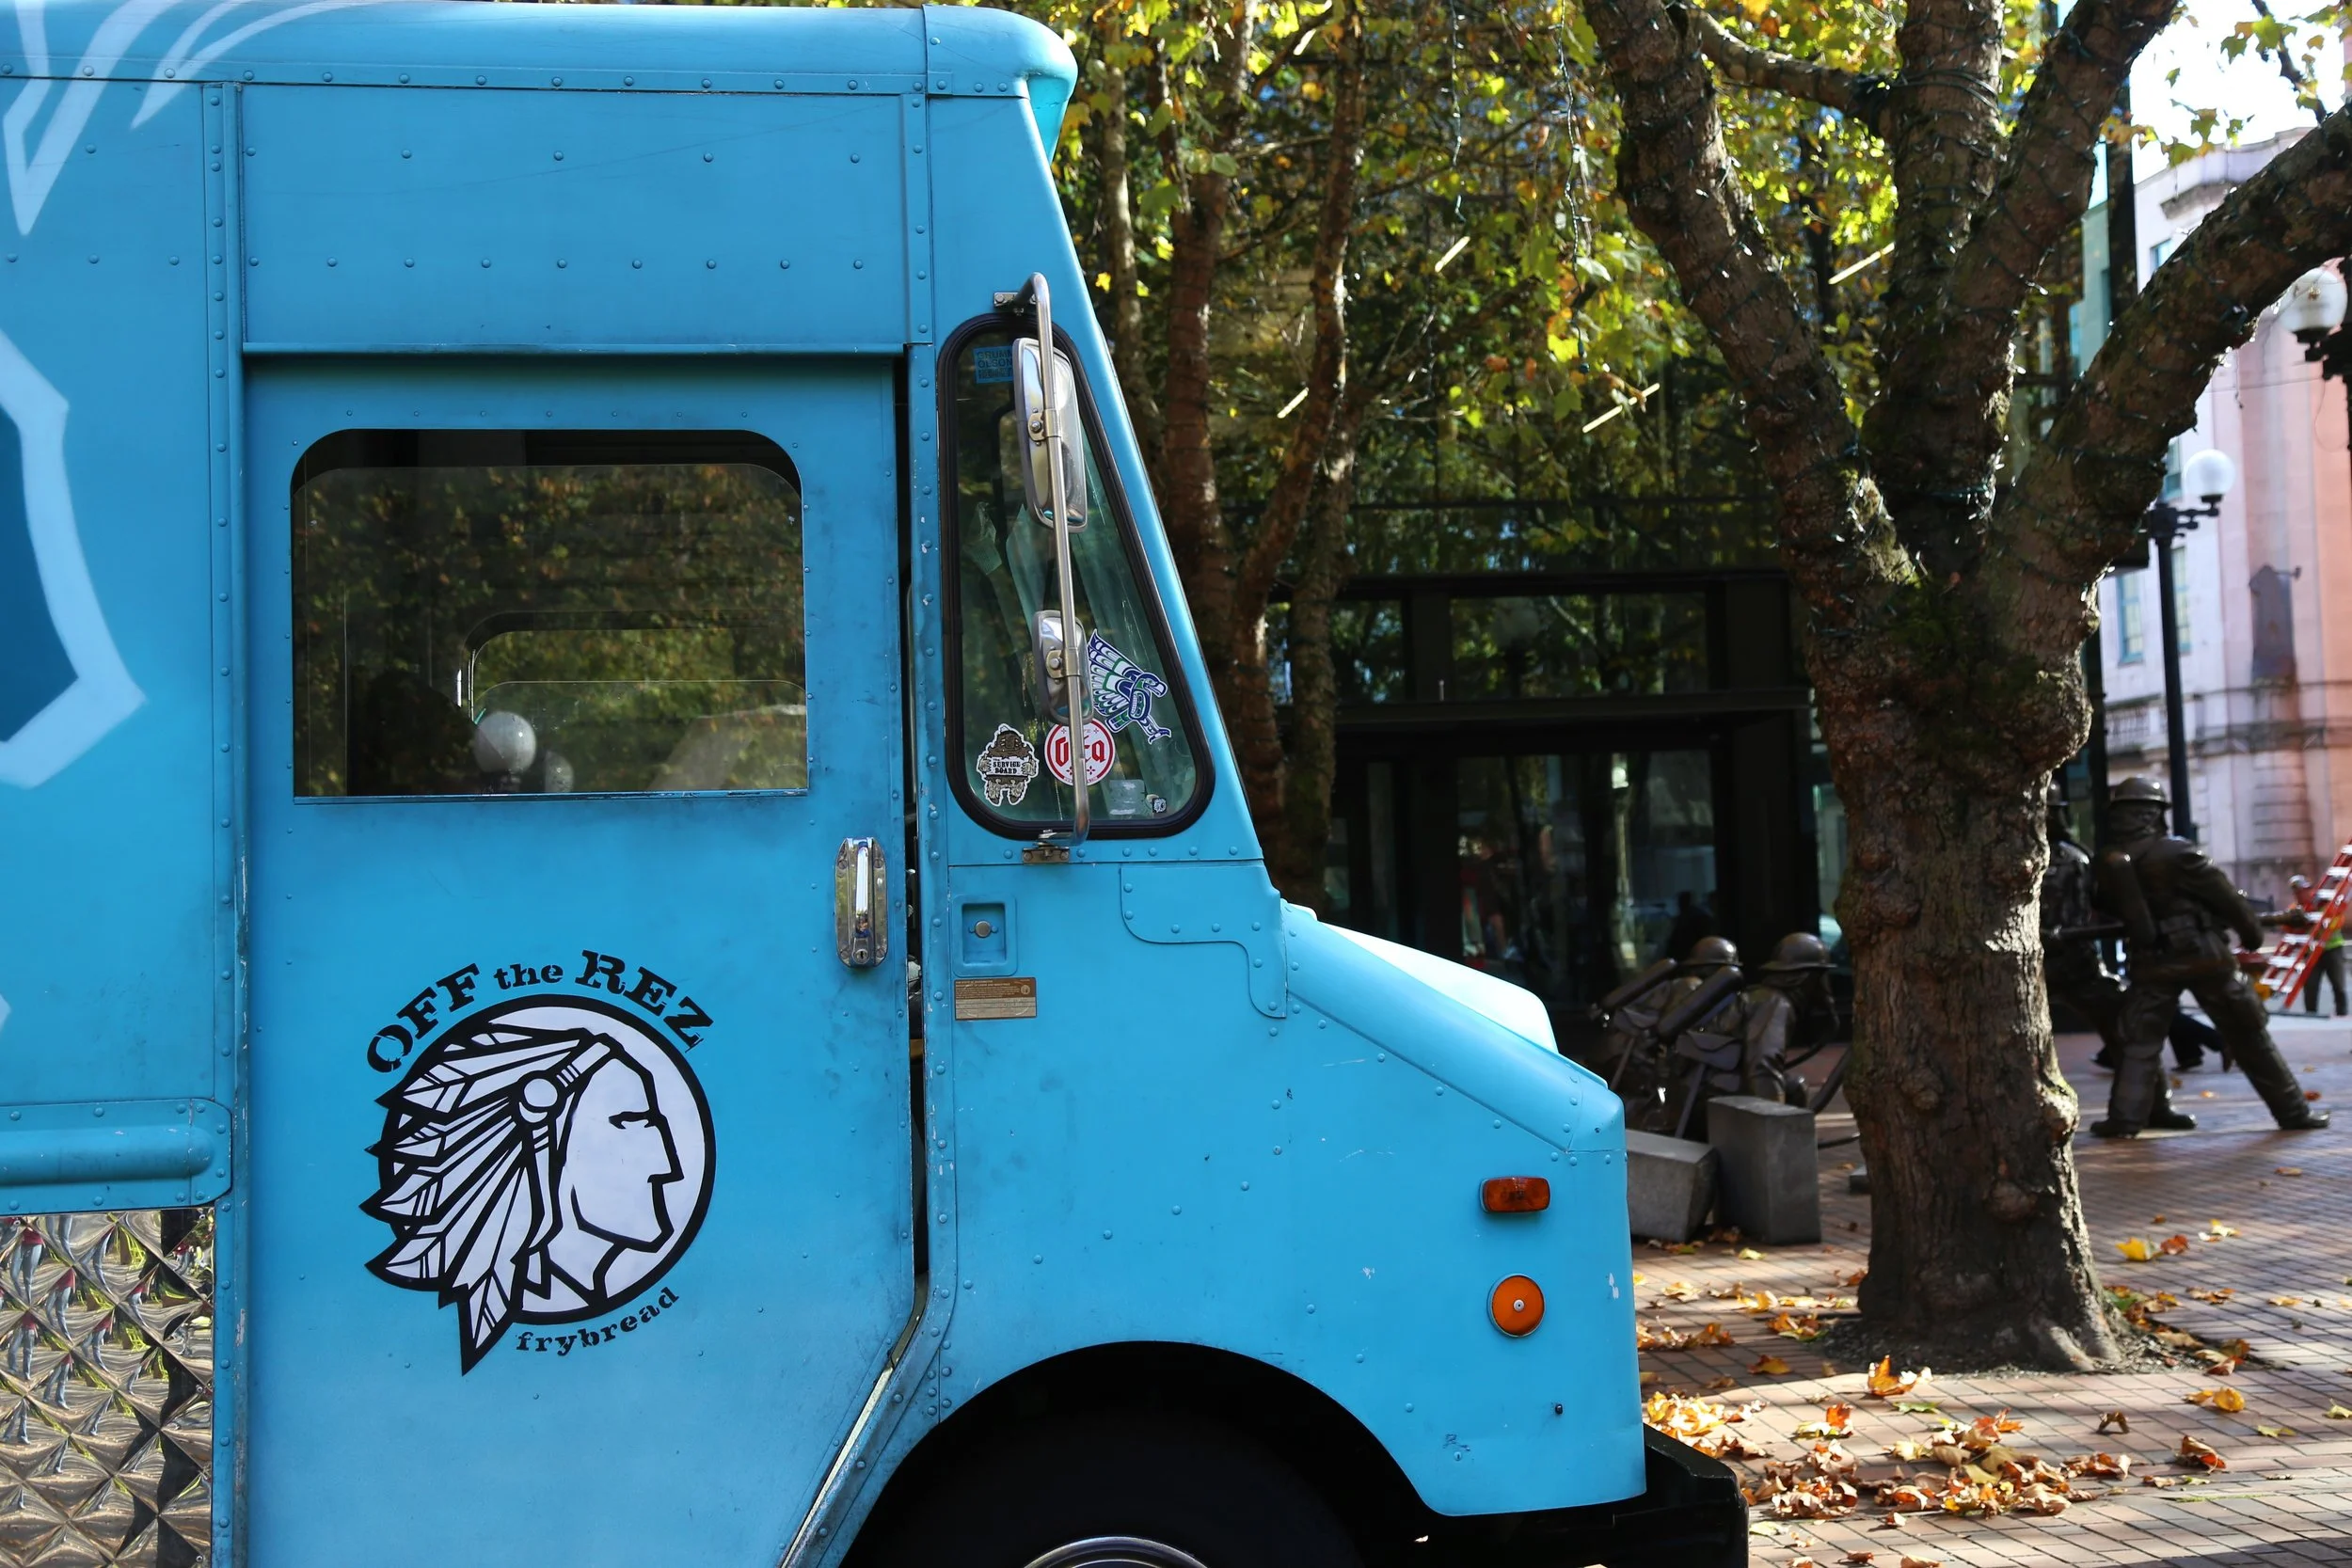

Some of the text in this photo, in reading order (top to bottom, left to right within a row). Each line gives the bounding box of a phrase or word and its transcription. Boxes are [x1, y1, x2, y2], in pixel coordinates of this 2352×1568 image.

[978, 358, 1012, 368] OLSON
[366, 949, 714, 1073] OFF the REZ
[516, 1286, 680, 1357] frybread
